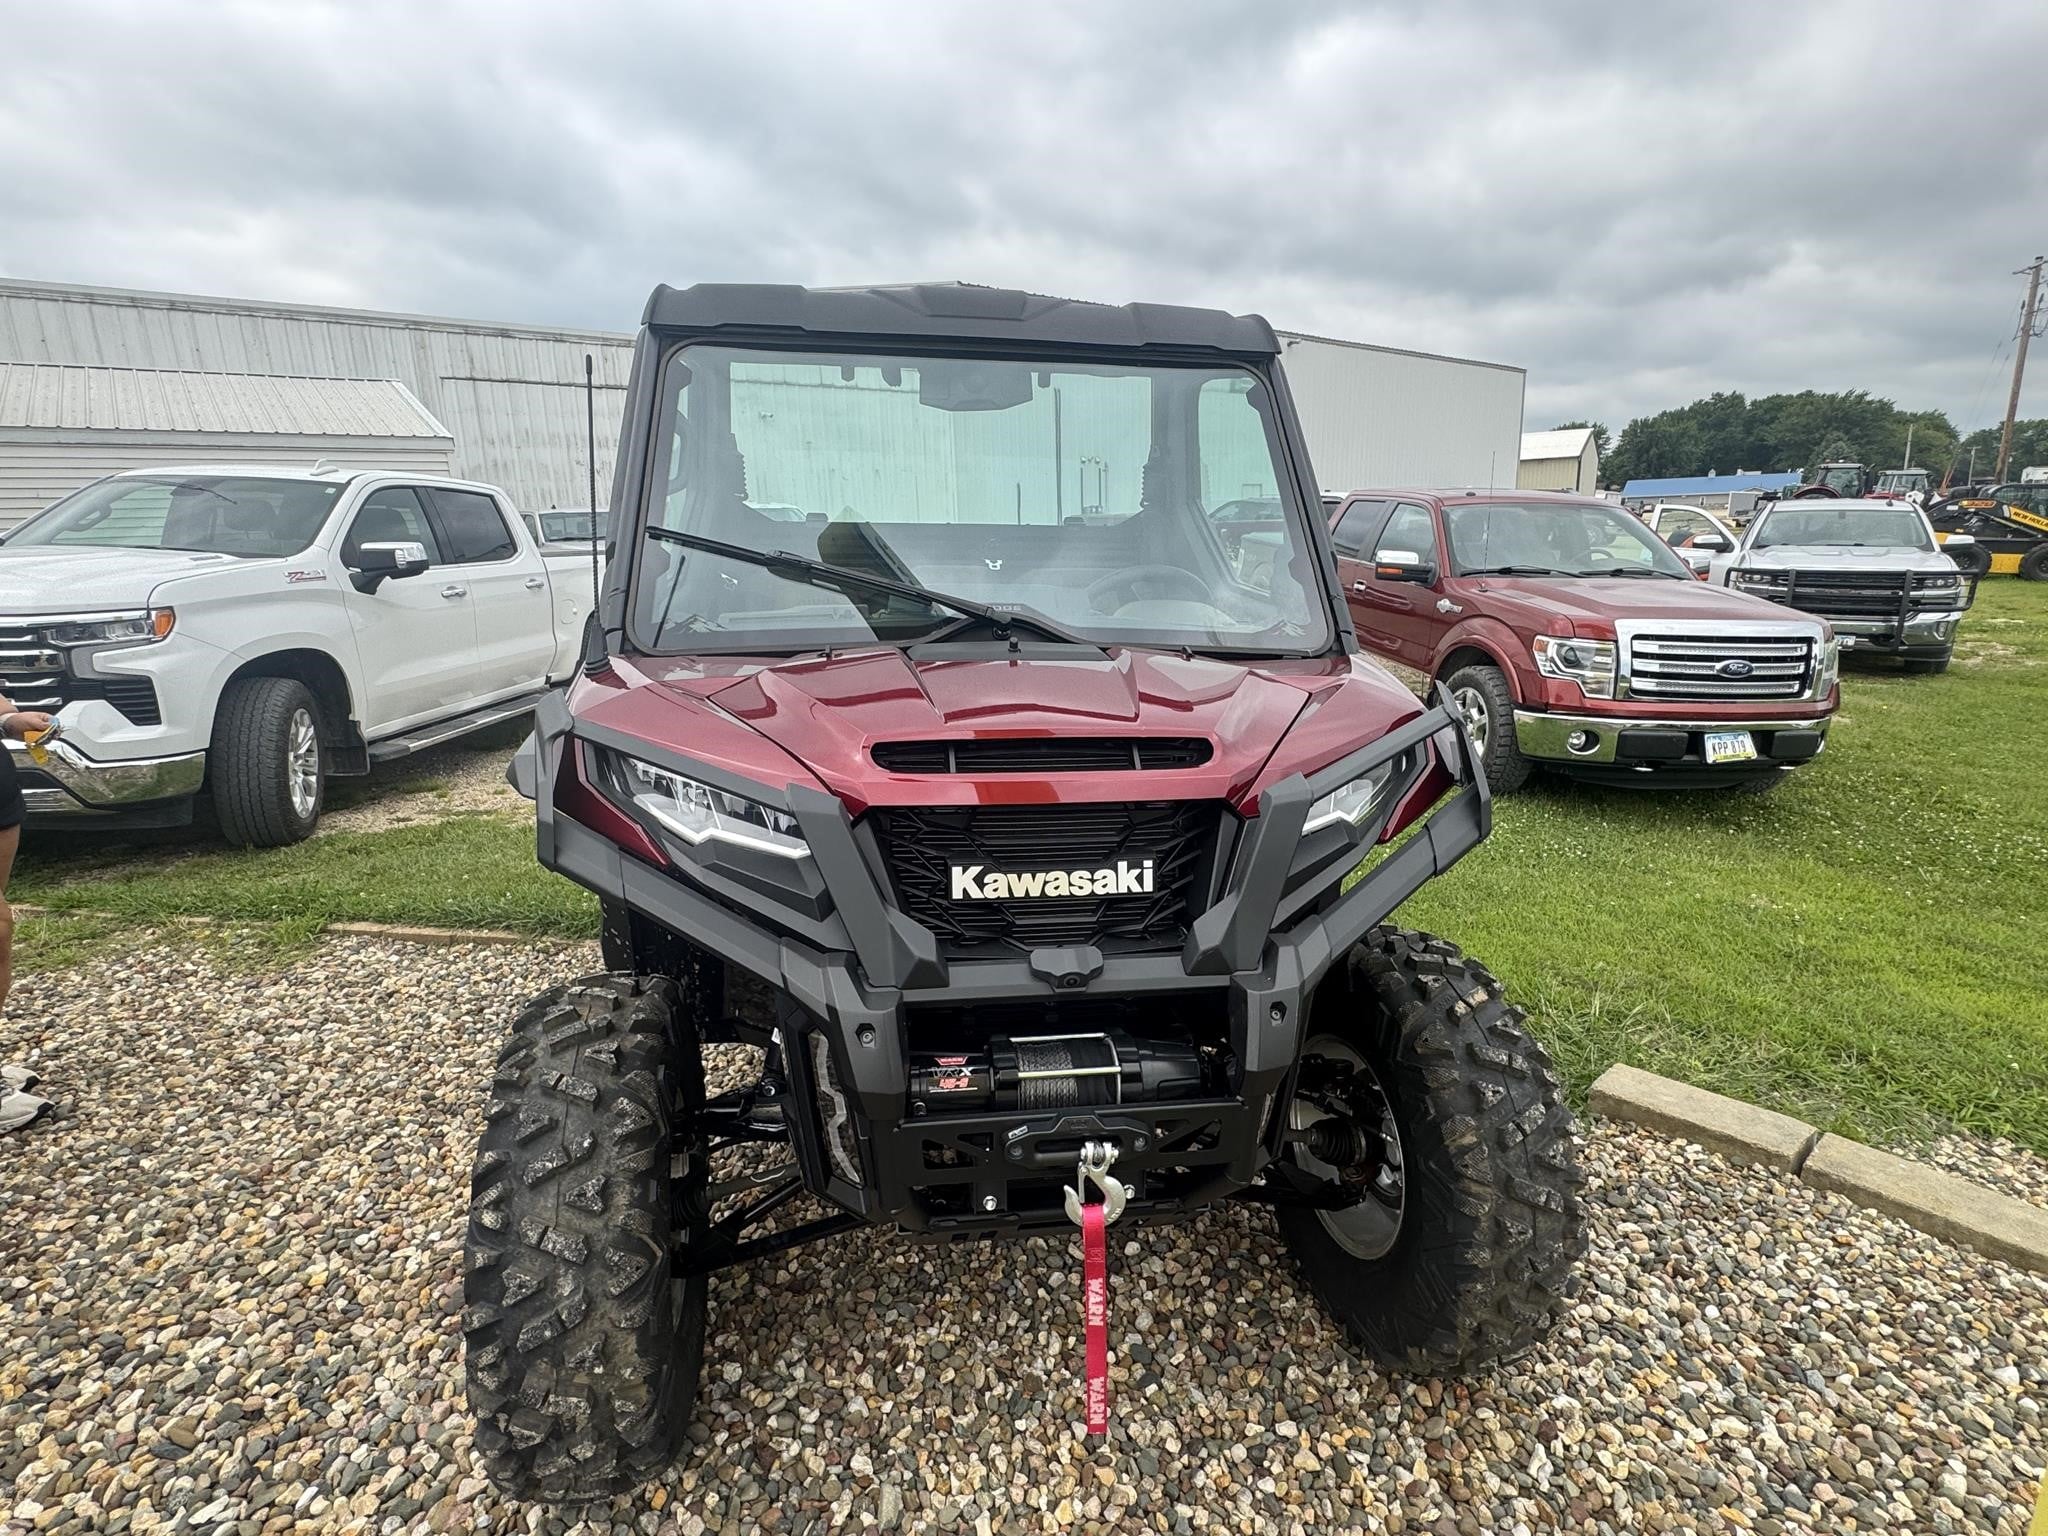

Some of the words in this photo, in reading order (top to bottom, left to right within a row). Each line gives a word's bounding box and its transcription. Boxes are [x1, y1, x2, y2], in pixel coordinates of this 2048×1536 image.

[1726, 663, 1749, 674] Ford
[1712, 741, 1729, 755] KPP
[1731, 740, 1747, 754] 879
[951, 859, 1154, 900] Kawasaki
[1088, 1277, 1104, 1327] WARN
[1089, 1376, 1105, 1425] WARN
